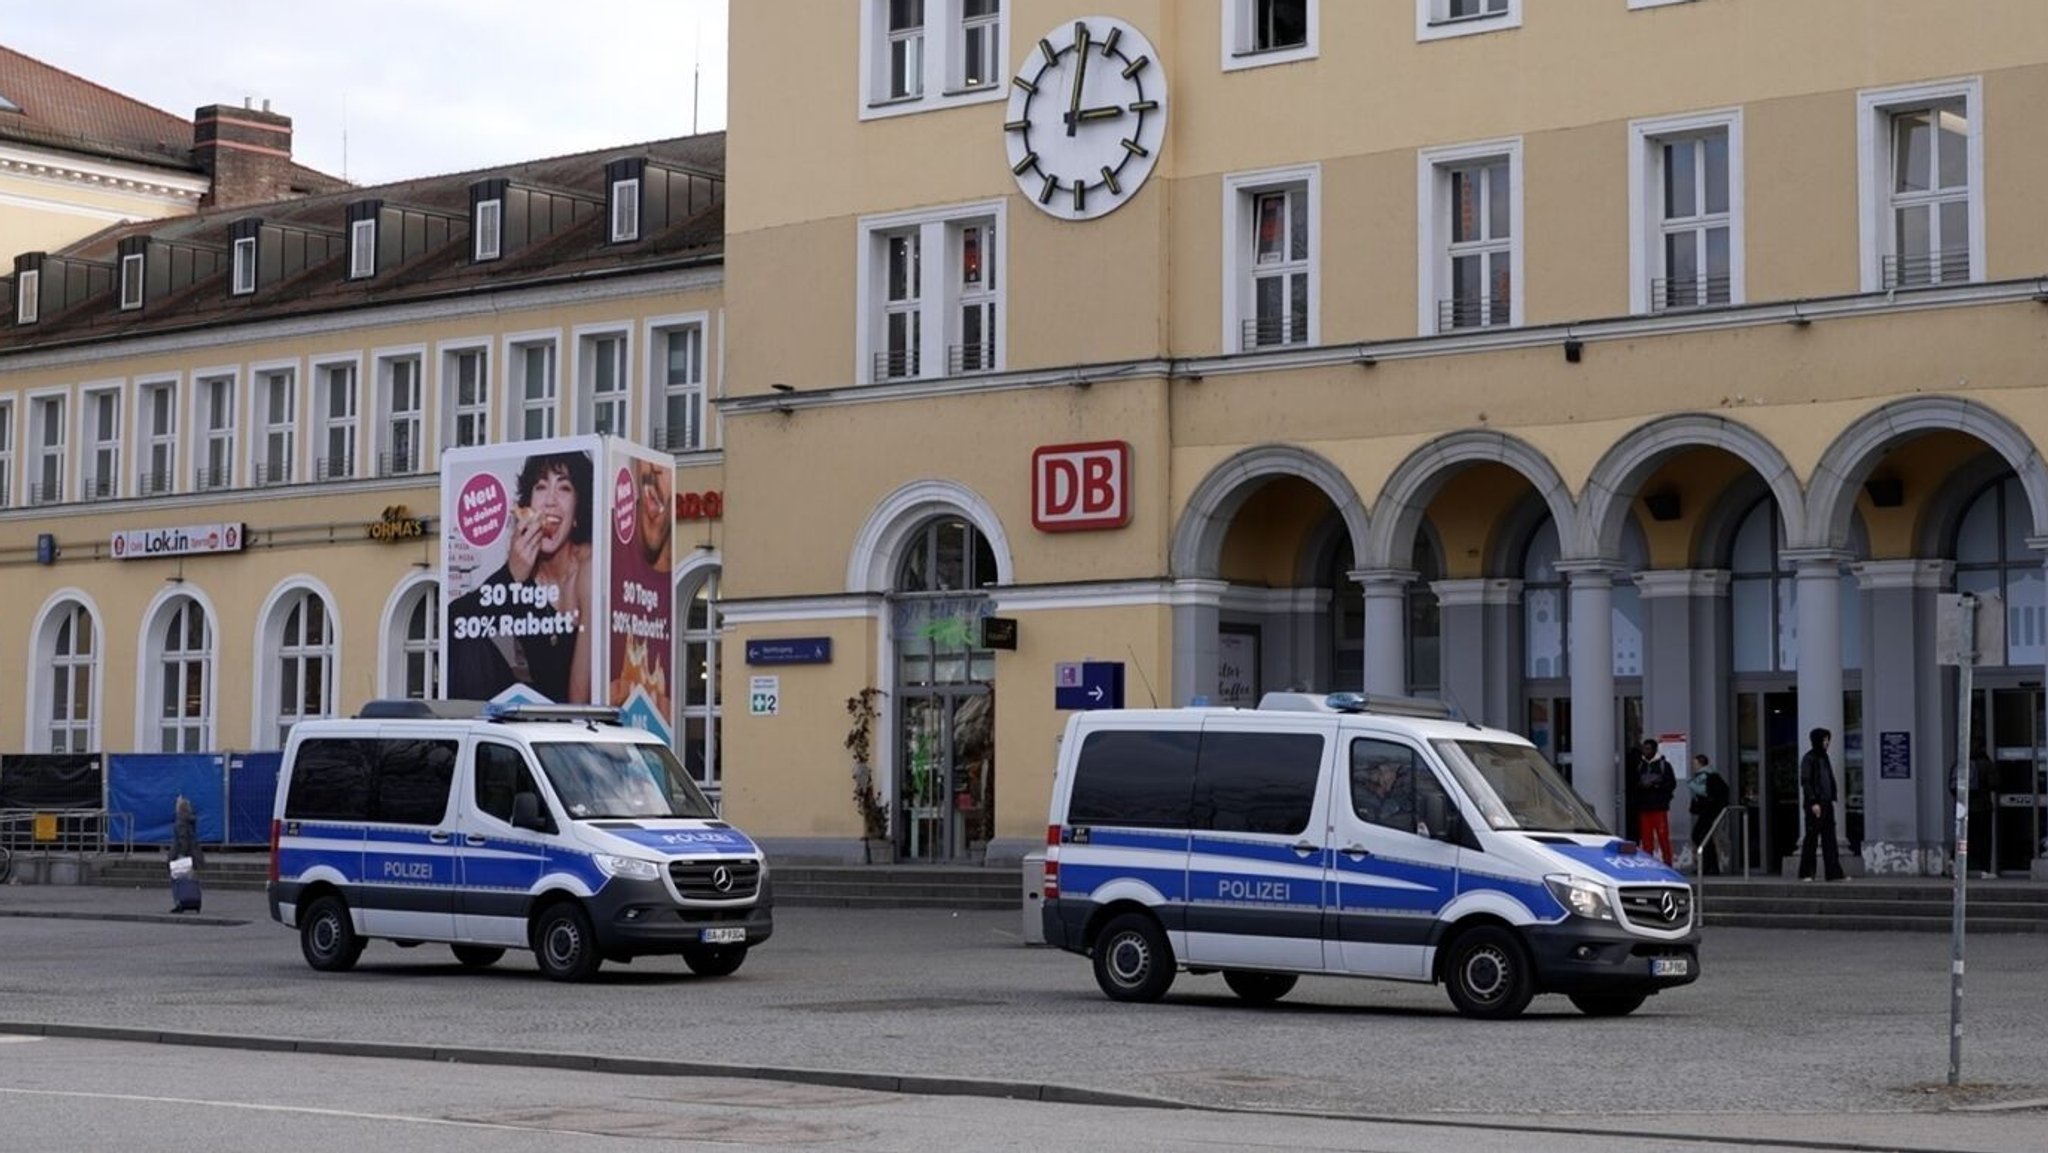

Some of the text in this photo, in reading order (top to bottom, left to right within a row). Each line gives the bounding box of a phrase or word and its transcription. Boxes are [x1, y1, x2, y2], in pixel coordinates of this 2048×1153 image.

[463, 484, 497, 511] Neu
[1045, 456, 1115, 516] DB
[473, 503, 502, 522] deiner
[472, 518, 499, 538] Stadt
[144, 529, 189, 553] Lok.in
[480, 582, 559, 609] 30 Tage
[623, 580, 658, 612] 30 Tage
[454, 615, 496, 639] 30%
[662, 833, 736, 844] POLIZEI
[384, 862, 433, 878] POLIZEI
[1219, 880, 1291, 901] POLIZEI
